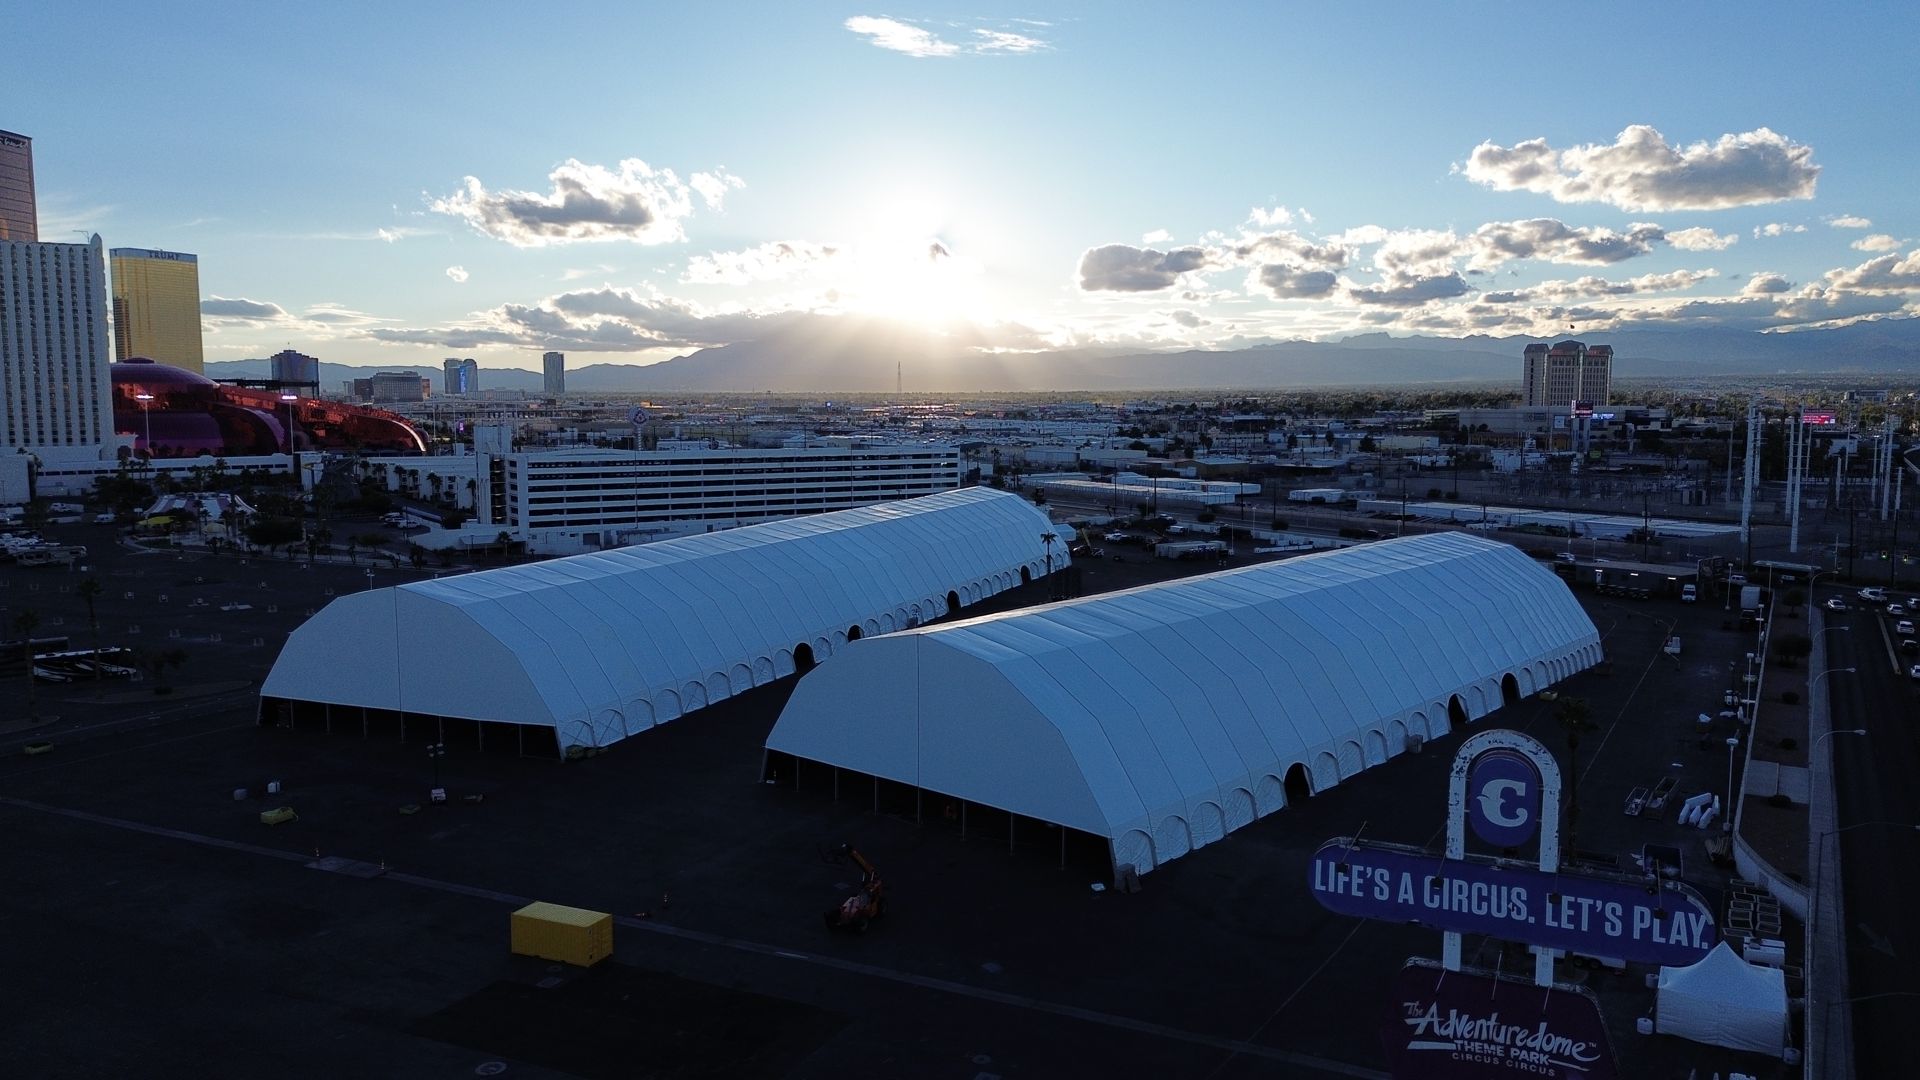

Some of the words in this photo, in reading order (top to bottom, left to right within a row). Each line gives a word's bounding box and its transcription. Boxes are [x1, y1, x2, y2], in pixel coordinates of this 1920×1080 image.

[149, 251, 179, 261] TRUMP
[1476, 778, 1528, 828] C
[1314, 859, 1390, 901] LIFE'S
[1397, 872, 1415, 905] A
[1423, 875, 1536, 924] CIRCUS.
[1545, 892, 1623, 937] LET'S
[1633, 905, 1709, 950] PLAY.
[1403, 1001, 1425, 1017] The
[1451, 1052, 1500, 1065] CIRCUS
[1505, 1059, 1556, 1077] CIRCUS
[1454, 1039, 1505, 1057] THEME
[1510, 1047, 1551, 1066] PARK
